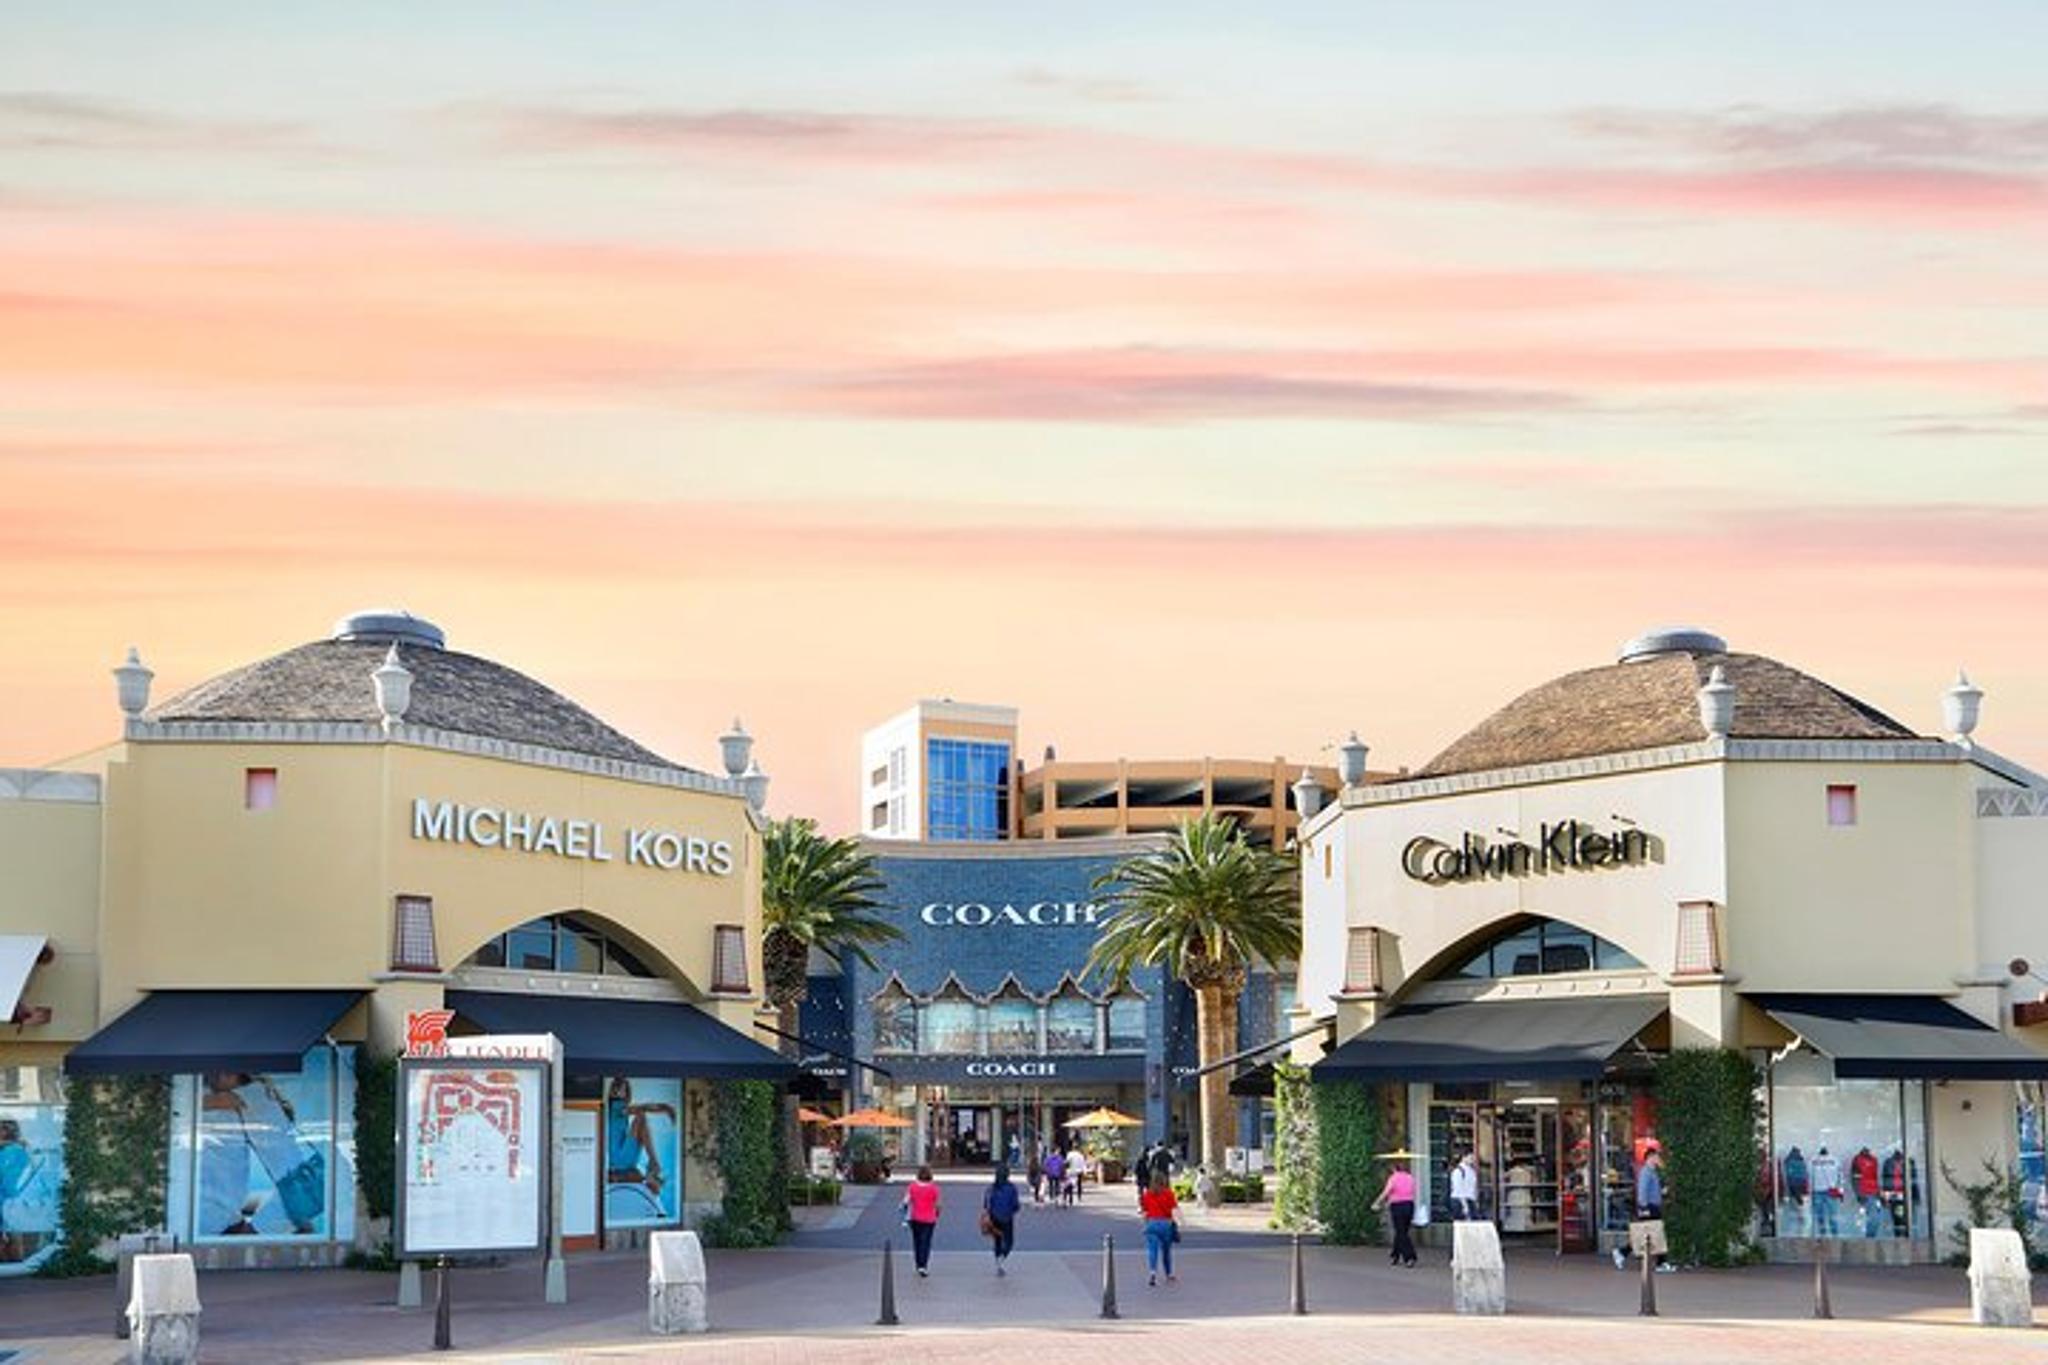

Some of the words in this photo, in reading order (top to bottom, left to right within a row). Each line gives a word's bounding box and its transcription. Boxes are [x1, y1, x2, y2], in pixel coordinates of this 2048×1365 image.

[413, 798, 612, 861] MICHAEL
[628, 828, 733, 875] KORS
[1402, 828, 1531, 884] Calvin
[1540, 815, 1650, 869] Klein
[921, 902, 1098, 926] COACH
[966, 1062, 1056, 1076] COACH
